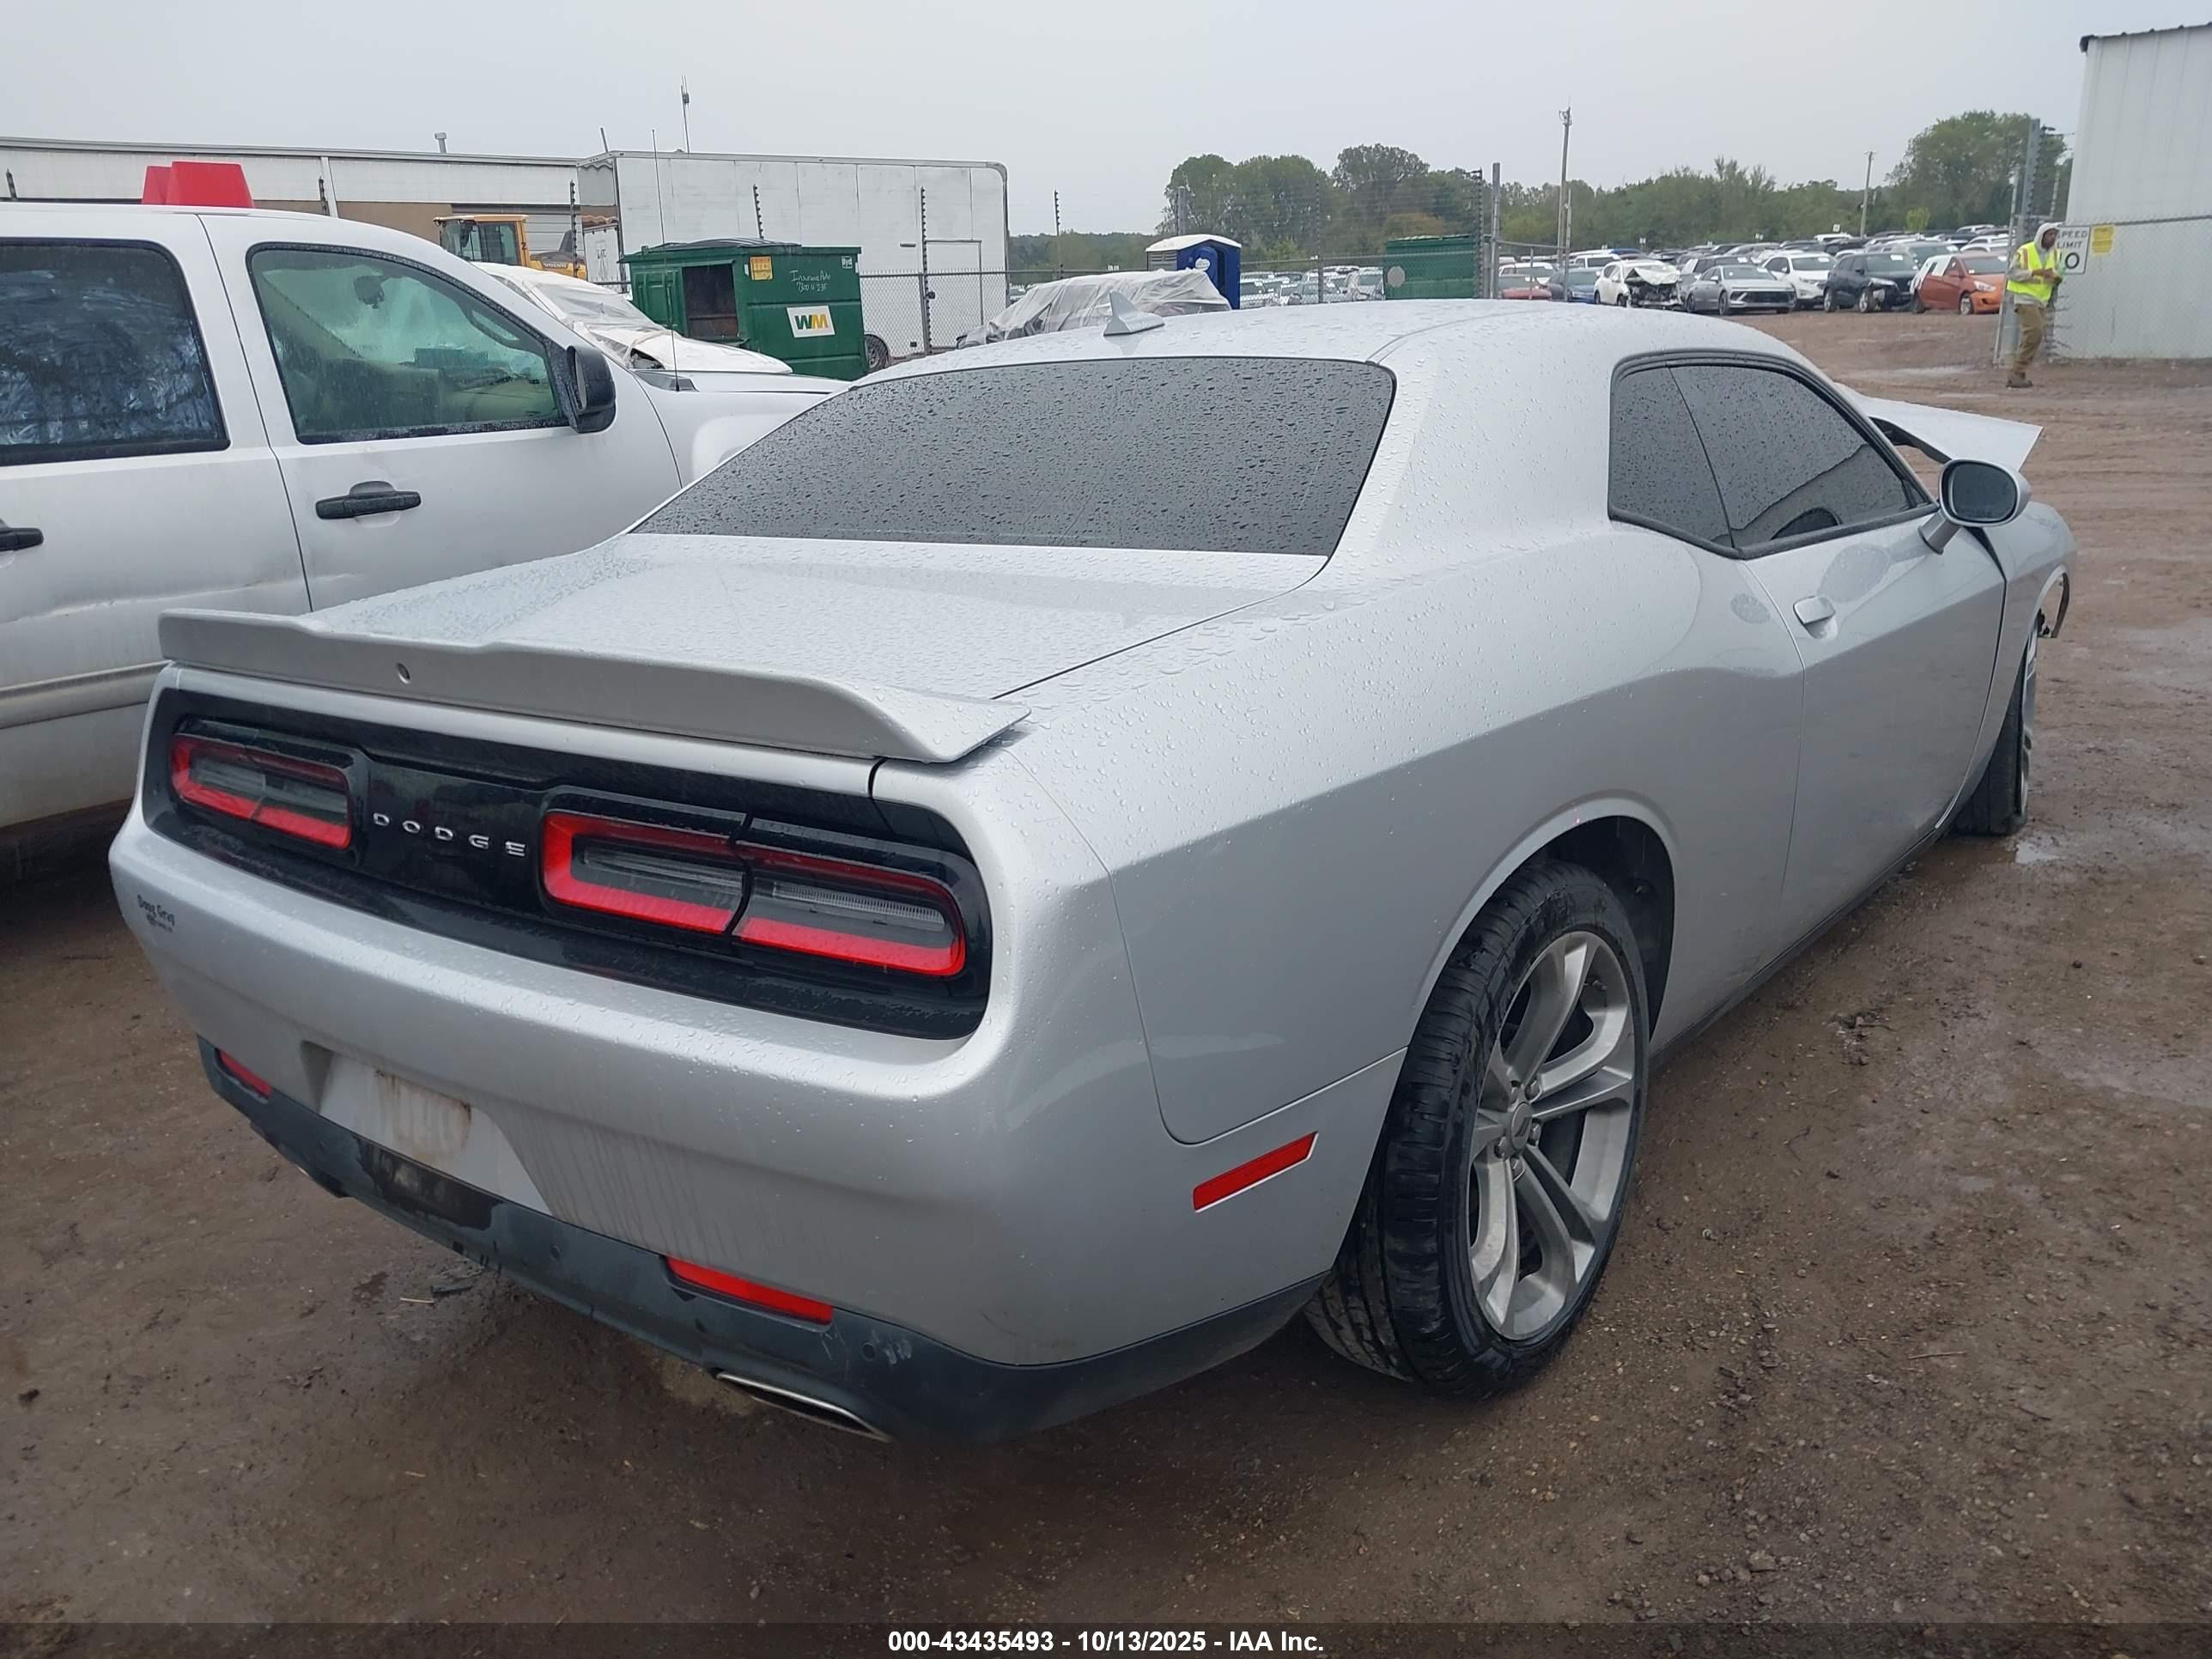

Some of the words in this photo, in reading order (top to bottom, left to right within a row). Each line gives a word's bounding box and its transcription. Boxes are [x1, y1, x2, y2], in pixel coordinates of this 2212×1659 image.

[2057, 240, 2082, 249] LIMIT
[794, 314, 829, 330] WM
[373, 812, 526, 857] DODGE
